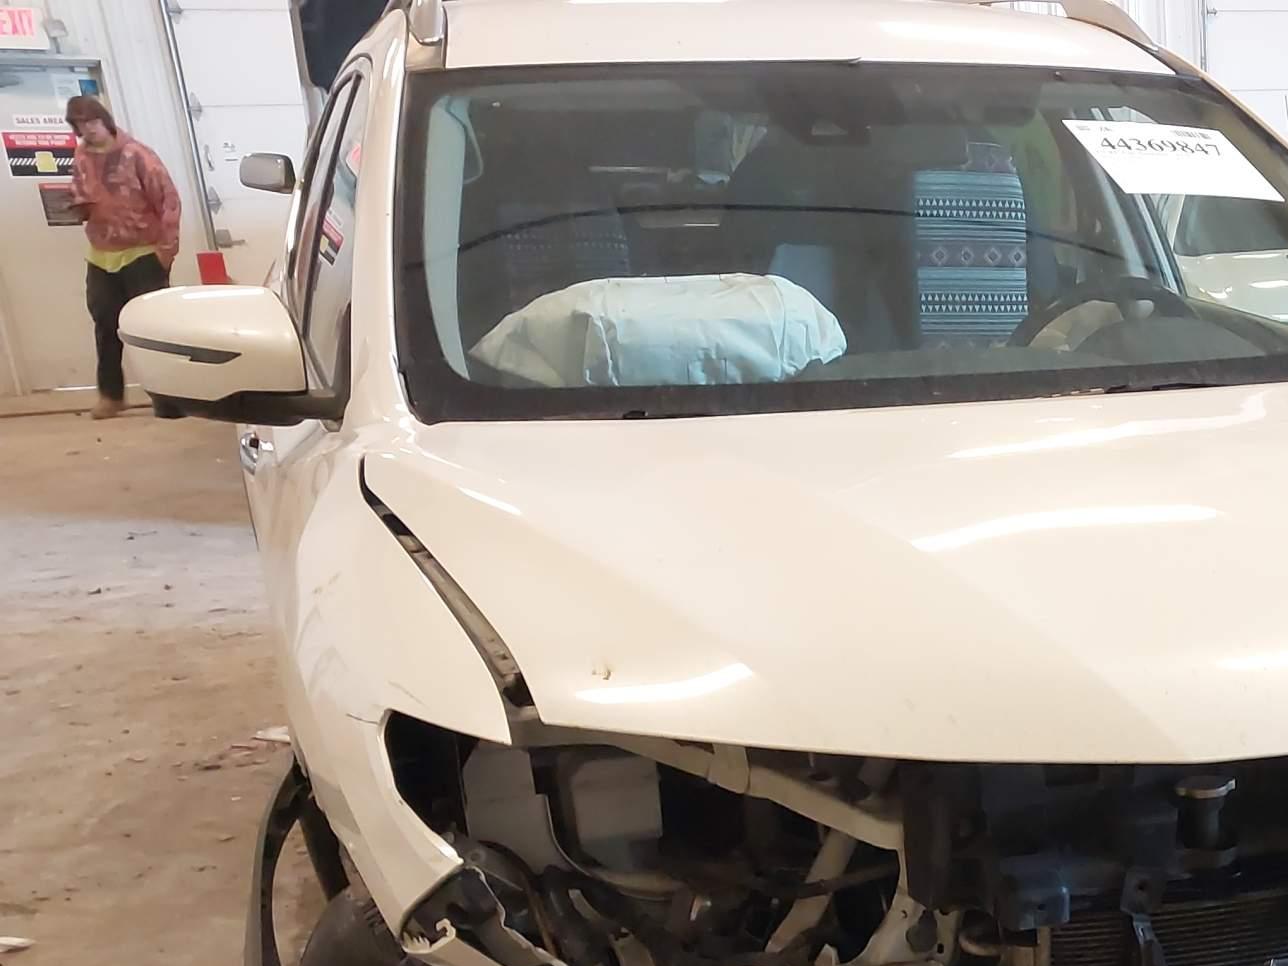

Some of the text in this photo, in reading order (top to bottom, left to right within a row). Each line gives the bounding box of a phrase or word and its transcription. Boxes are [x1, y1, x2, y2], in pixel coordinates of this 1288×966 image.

[0, 9, 34, 36] EXIT
[16, 116, 64, 124] SALES AREA
[1100, 137, 1221, 156] 44369847
